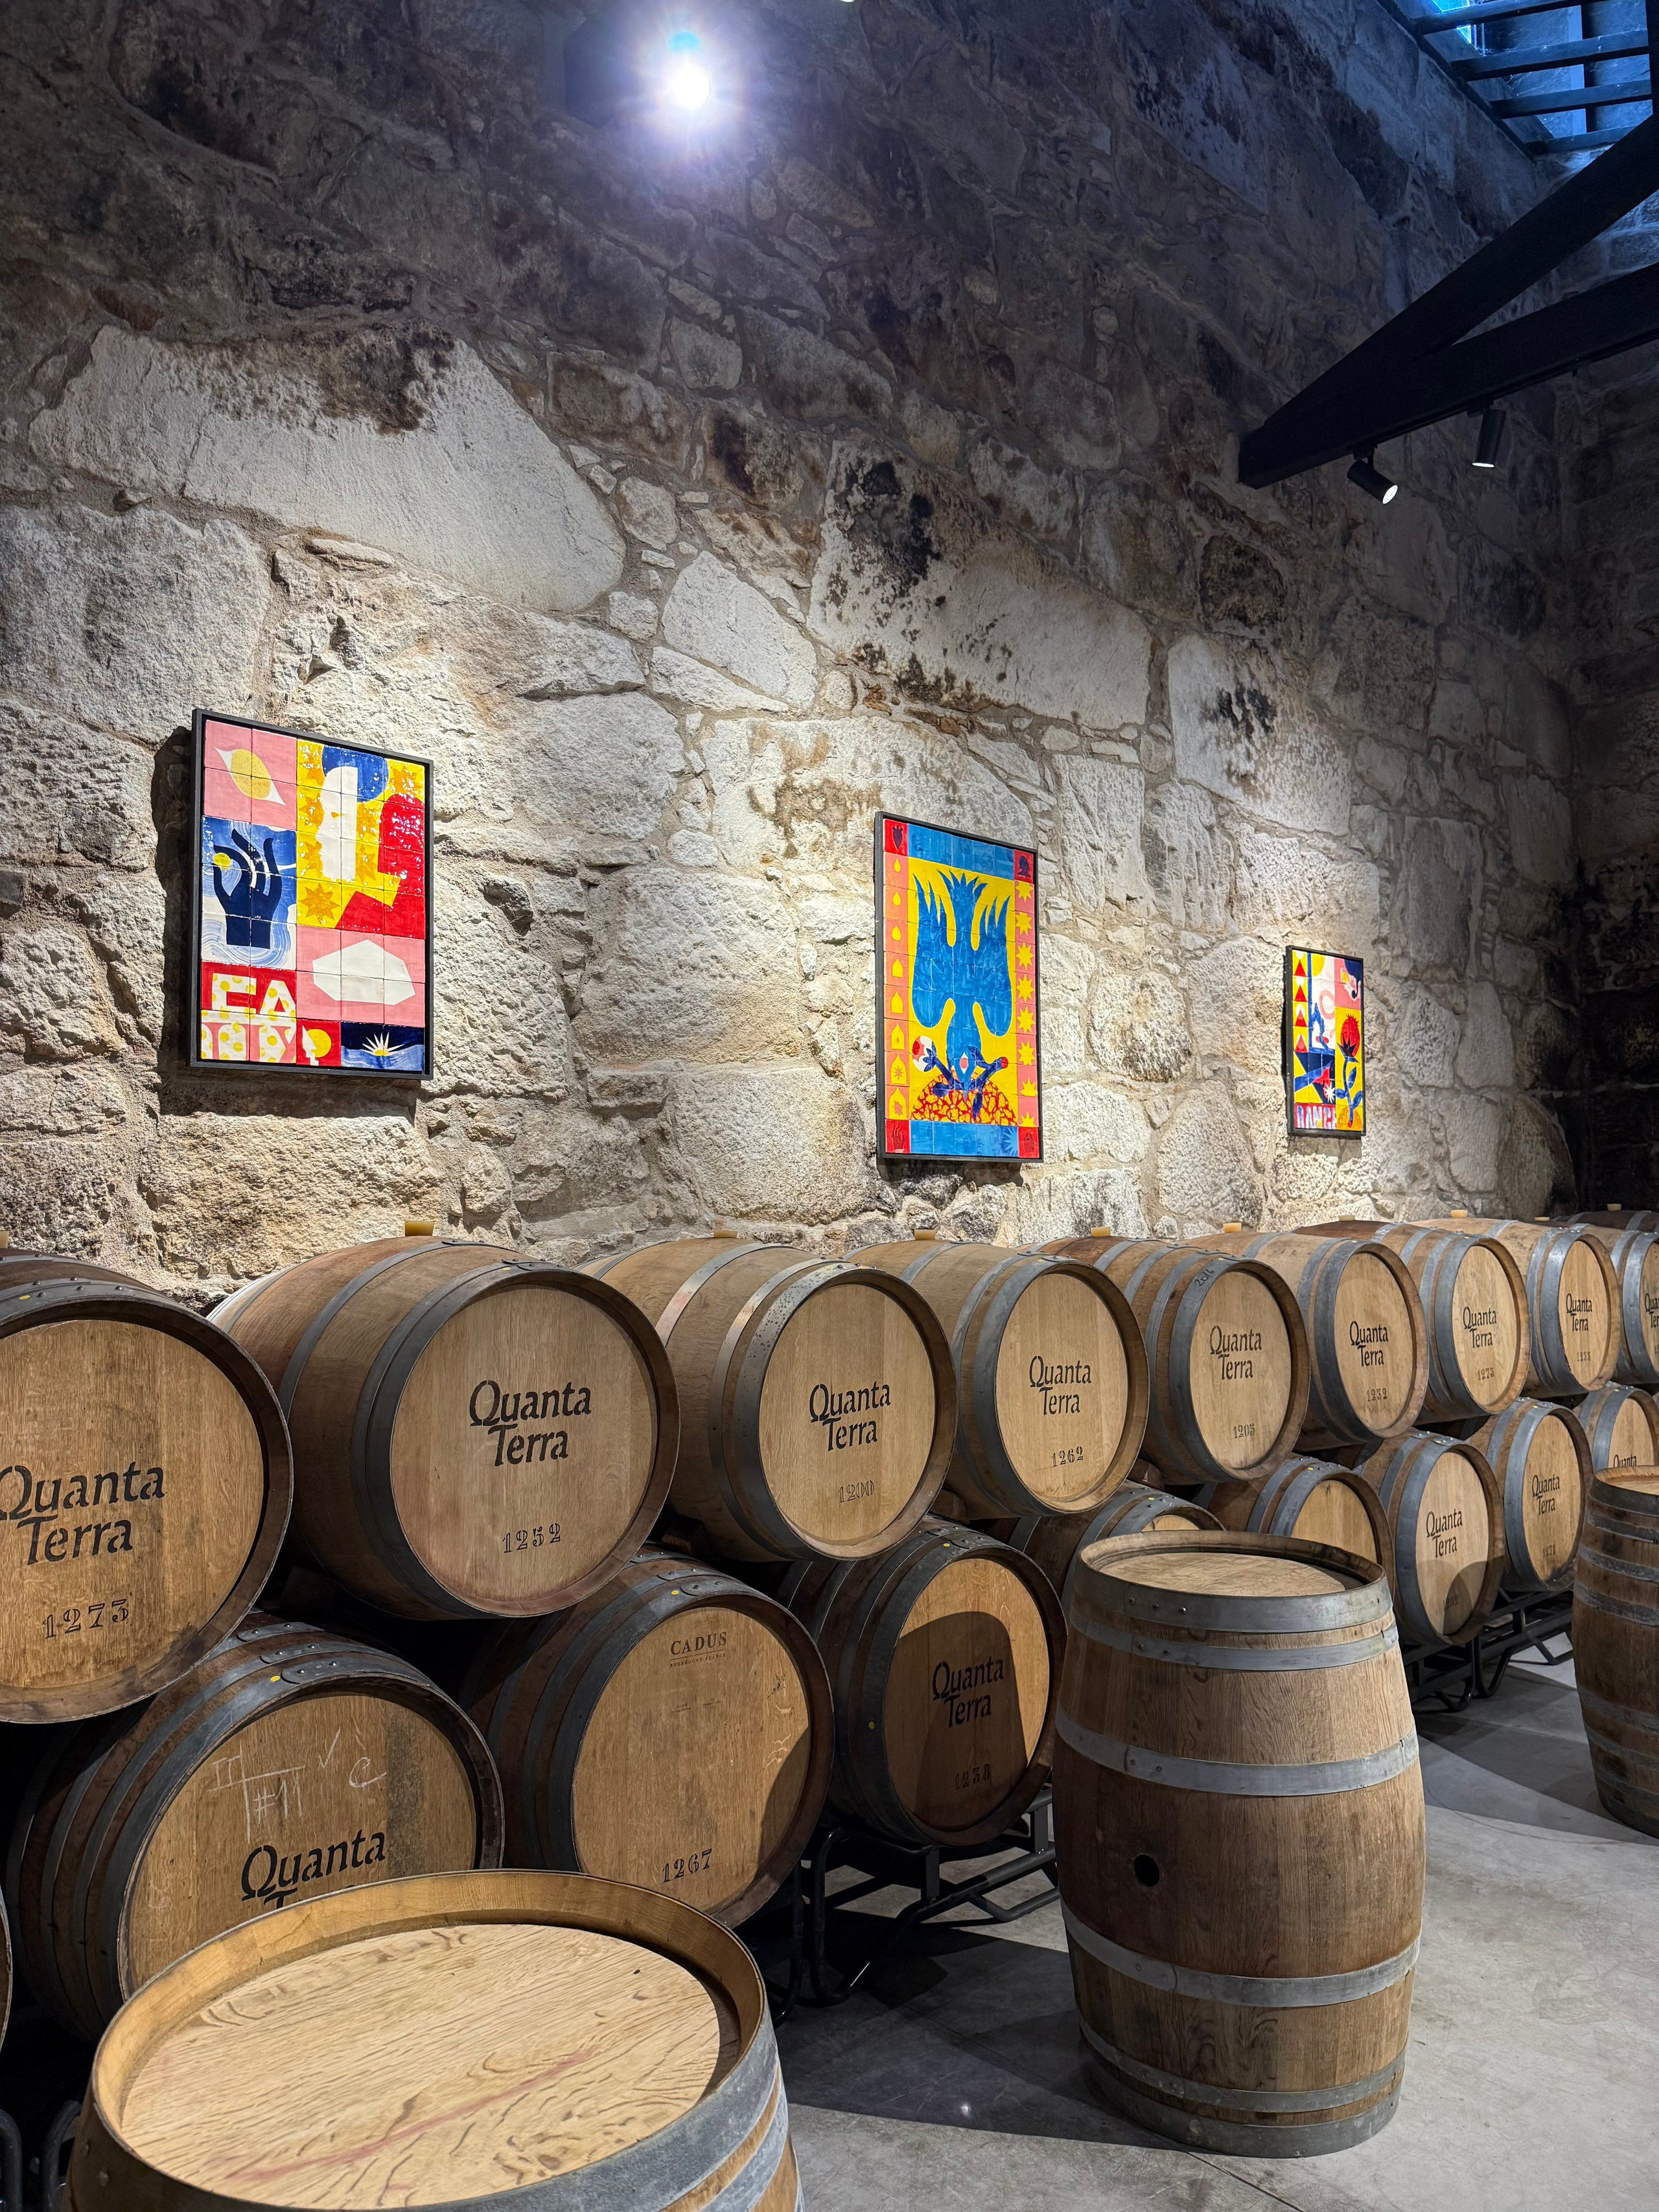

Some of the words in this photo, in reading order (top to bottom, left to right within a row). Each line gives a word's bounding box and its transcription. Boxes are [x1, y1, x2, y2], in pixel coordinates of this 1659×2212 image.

[1463, 1307, 1497, 1329] Quanta
[1566, 1293, 1592, 1313] Quanta
[1349, 1321, 1389, 1346] Quanta
[1570, 1312, 1589, 1331] Terra
[1210, 1325, 1262, 1355] Quanta
[1469, 1329, 1493, 1348] Terra
[1218, 1354, 1253, 1380] Terra
[1357, 1345, 1384, 1367] Terra
[1029, 1355, 1091, 1388] Quanta
[470, 1380, 592, 1426] Quanta
[809, 1381, 891, 1423] Quanta
[1039, 1387, 1080, 1415] Terra
[489, 1425, 569, 1467] Terra
[822, 1417, 878, 1452] Terra
[1233, 1423, 1255, 1439] 1205
[1051, 1445, 1084, 1467] 1262
[0, 1461, 166, 1520] Quanta
[1531, 1475, 1560, 1497] Quanta
[1537, 1496, 1556, 1515] Terra
[502, 1523, 561, 1553] 1252
[1426, 1508, 1463, 1538] Quanta
[17, 1516, 133, 1565] Terra
[1432, 1533, 1457, 1558] Terra
[42, 1598, 130, 1638] 1273
[670, 1631, 727, 1656] CADUS
[932, 1656, 1004, 1701] Quanta
[944, 1692, 992, 1729] Terra
[241, 1829, 386, 1902] Quanta
[662, 1848, 712, 1883] 1267
